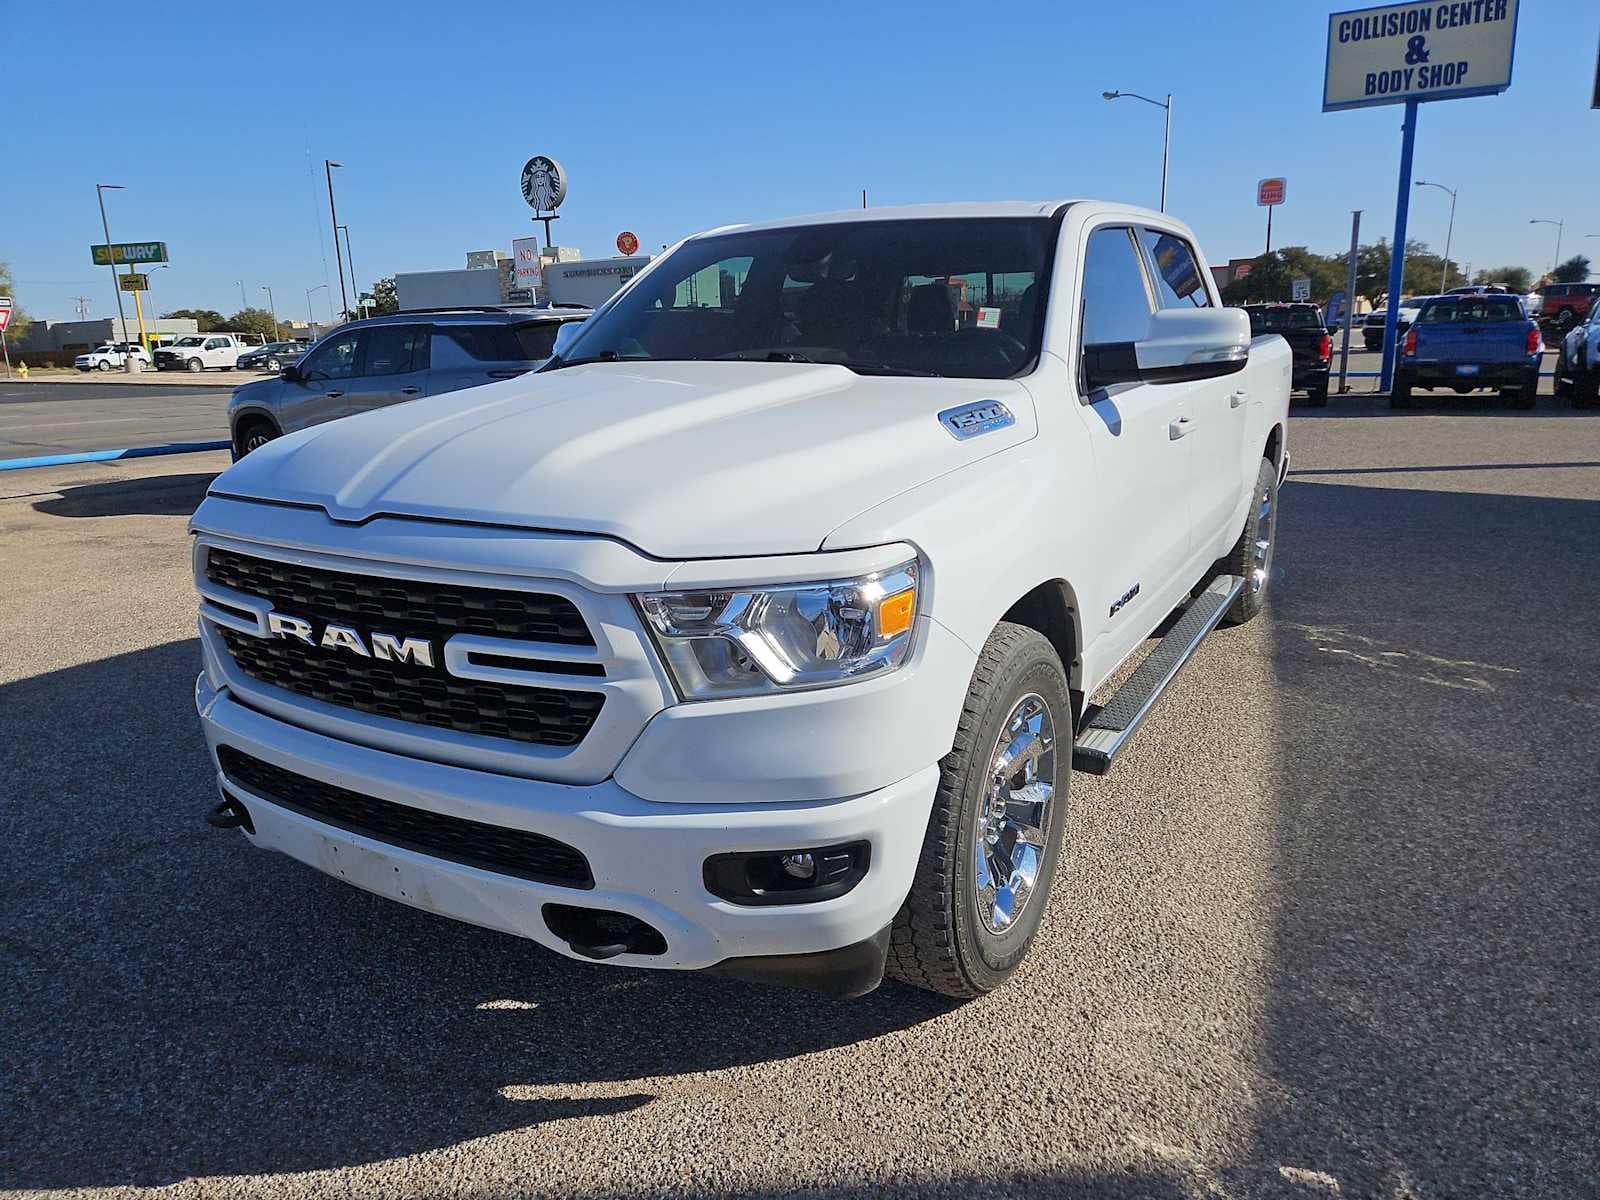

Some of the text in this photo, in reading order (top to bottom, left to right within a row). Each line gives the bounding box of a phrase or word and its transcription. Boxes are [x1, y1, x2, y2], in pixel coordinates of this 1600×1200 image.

[1338, 0, 1507, 43] COLLISION CENTER
[1405, 35, 1429, 65] &
[1365, 61, 1468, 96] BODY SHOP
[95, 245, 158, 259] SUBWAY
[520, 249, 532, 261] NO
[517, 267, 539, 277] PARKING
[268, 610, 434, 668] RAM
